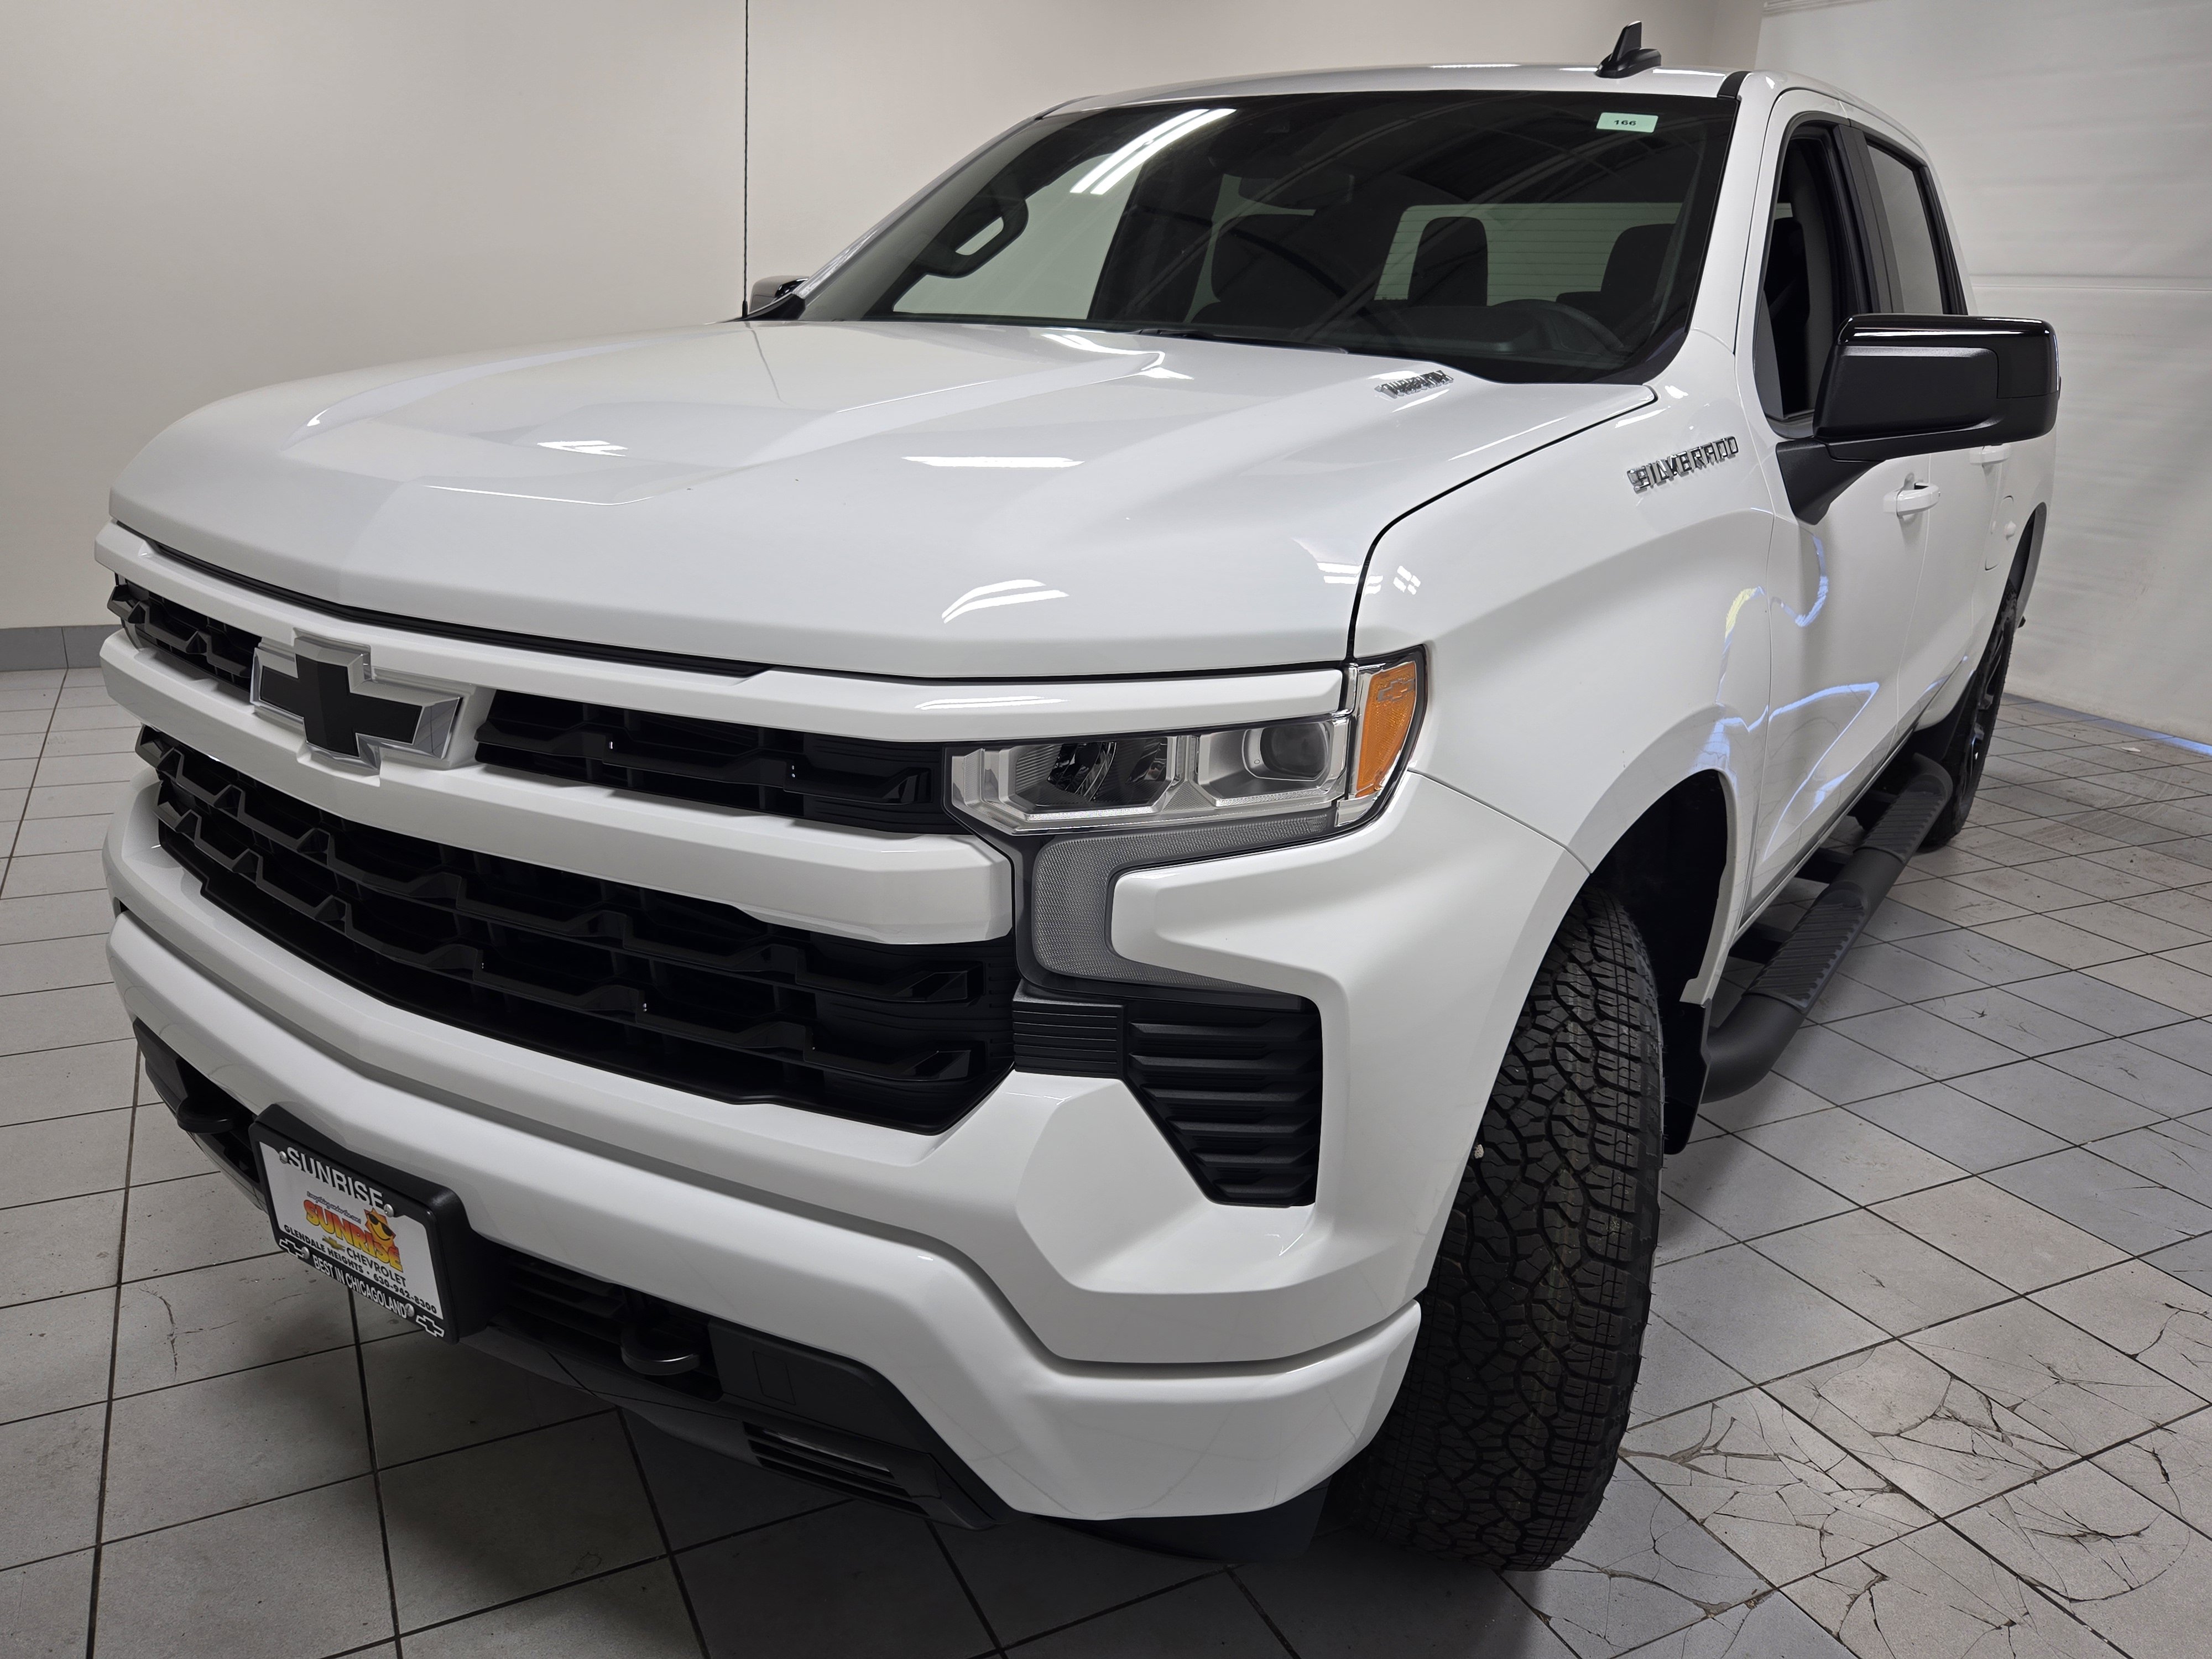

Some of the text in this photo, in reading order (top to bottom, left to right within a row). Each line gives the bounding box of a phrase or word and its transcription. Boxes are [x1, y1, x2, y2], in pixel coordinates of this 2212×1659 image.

[1627, 436, 1739, 494] SILVERADO
[287, 1147, 385, 1212] SUNRISE
[304, 1199, 403, 1272] SUNRISE
[346, 1247, 406, 1287] CHEVROLET
[284, 1224, 437, 1314] GLENDALE HEIGHTS 630-942-8300
[312, 1254, 407, 1319] BEST IN CHICAGOLAND
